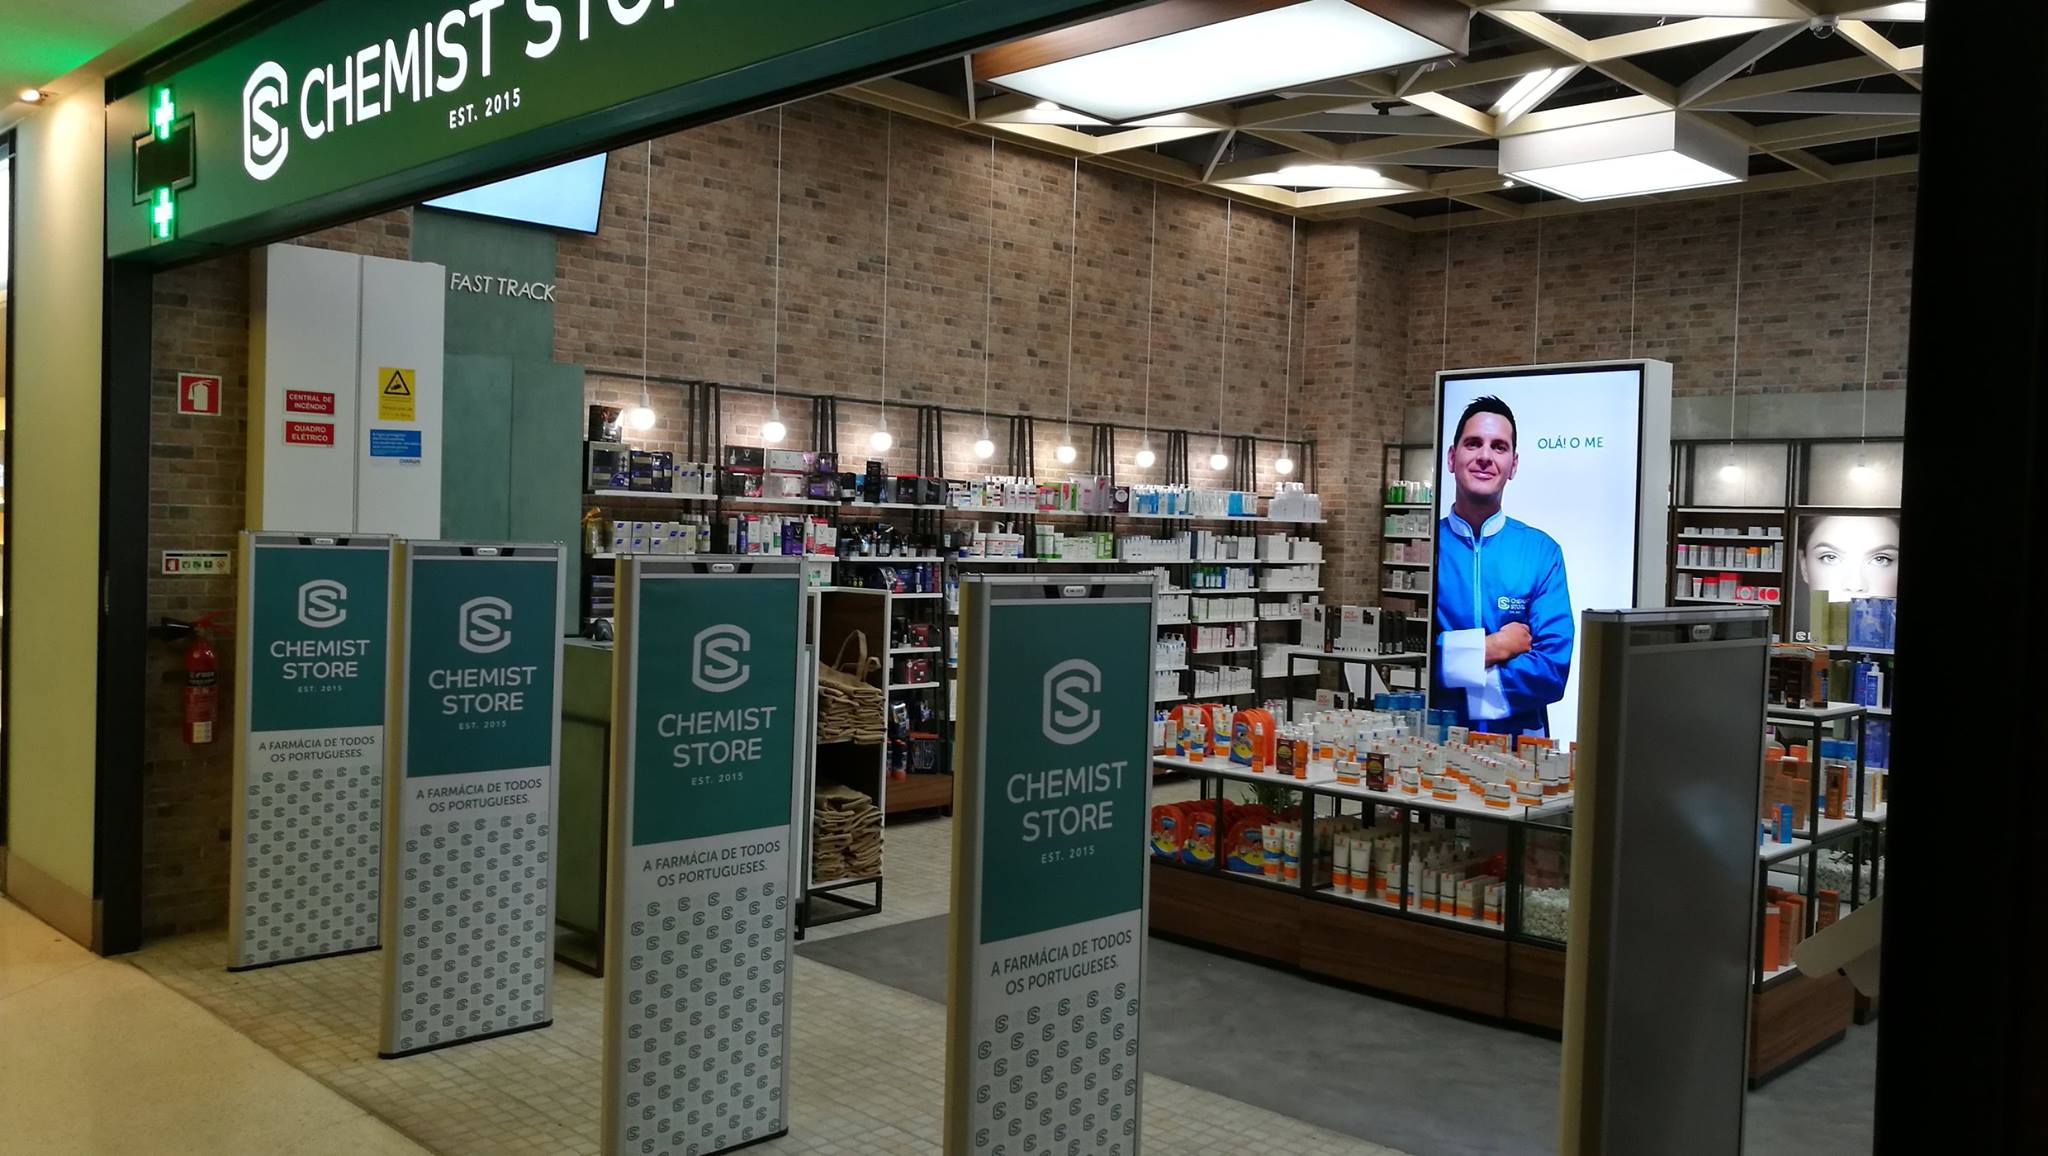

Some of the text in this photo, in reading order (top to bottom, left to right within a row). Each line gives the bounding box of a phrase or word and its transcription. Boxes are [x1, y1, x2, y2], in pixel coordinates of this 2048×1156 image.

[300, 0, 508, 140] CHEMIST
[449, 88, 521, 129] EST. 2015
[450, 272, 556, 302] FAST TRACK
[288, 393, 320, 402] CENTRAL
[294, 425, 327, 433] QUADRO
[1537, 435, 1604, 450] OLÁ! O ME
[270, 640, 370, 658] CHEMIST
[282, 661, 358, 679] STORE
[428, 666, 537, 690] CHEMIST
[442, 692, 523, 715] STORE
[459, 720, 507, 730] EST. 2015
[657, 706, 777, 738] CHEMIST
[259, 735, 375, 751] A FARMÁCIA DE TODOS
[673, 737, 762, 768] STORE
[270, 749, 362, 762] OS PORTUGUESES.
[416, 779, 542, 800] A FARMÁCIA DE TODOS
[691, 772, 744, 786] EST. 2015
[1007, 760, 1128, 804] CHEMIST
[428, 794, 530, 813] OS PORTUGUESES.
[1022, 801, 1113, 842] STORE
[643, 839, 780, 873] A FARMÁCIA DE TODOS
[1041, 845, 1095, 864] EST. 2015
[657, 859, 768, 888] OS PORTUGUESES.
[990, 929, 1132, 977] A FARMÁCIA DE TODOS
[1005, 953, 1119, 996] OS PORTUGUESES.
